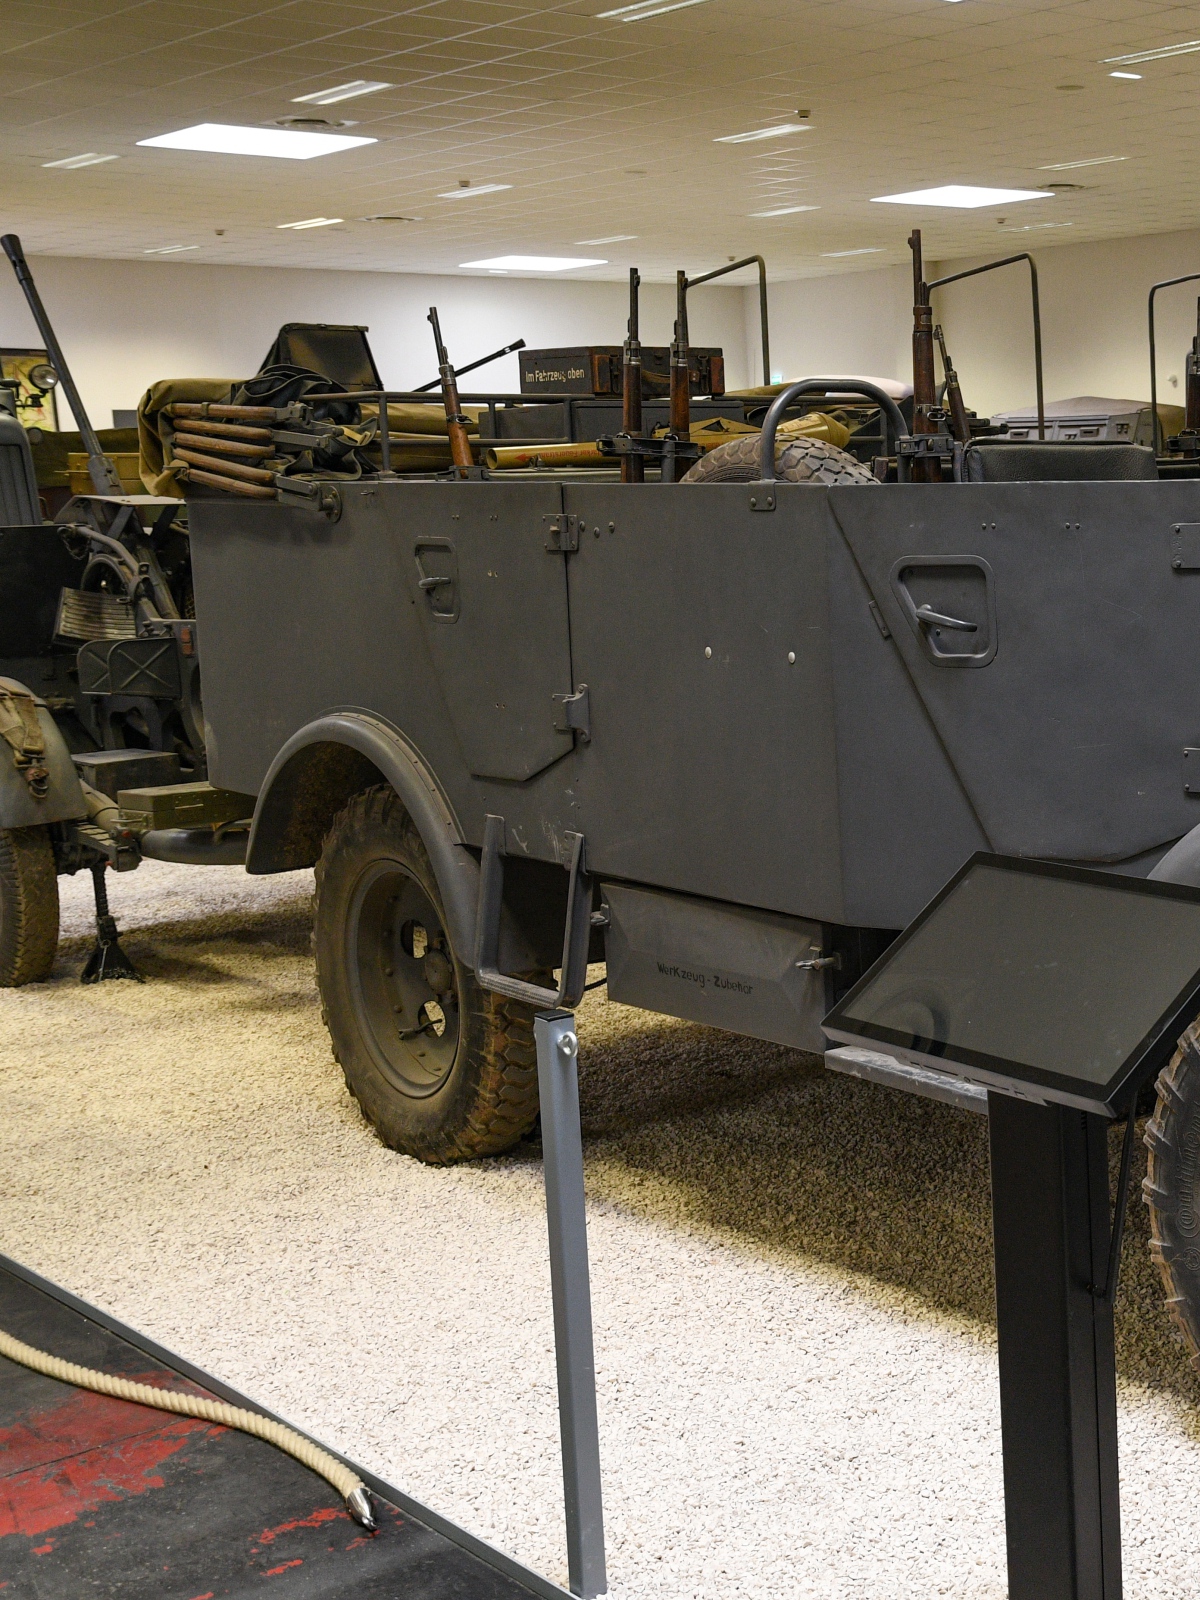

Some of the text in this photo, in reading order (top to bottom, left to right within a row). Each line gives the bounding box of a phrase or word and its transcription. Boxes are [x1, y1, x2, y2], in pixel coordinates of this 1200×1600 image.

[525, 367, 585, 383] Im Fahrzeug oben
